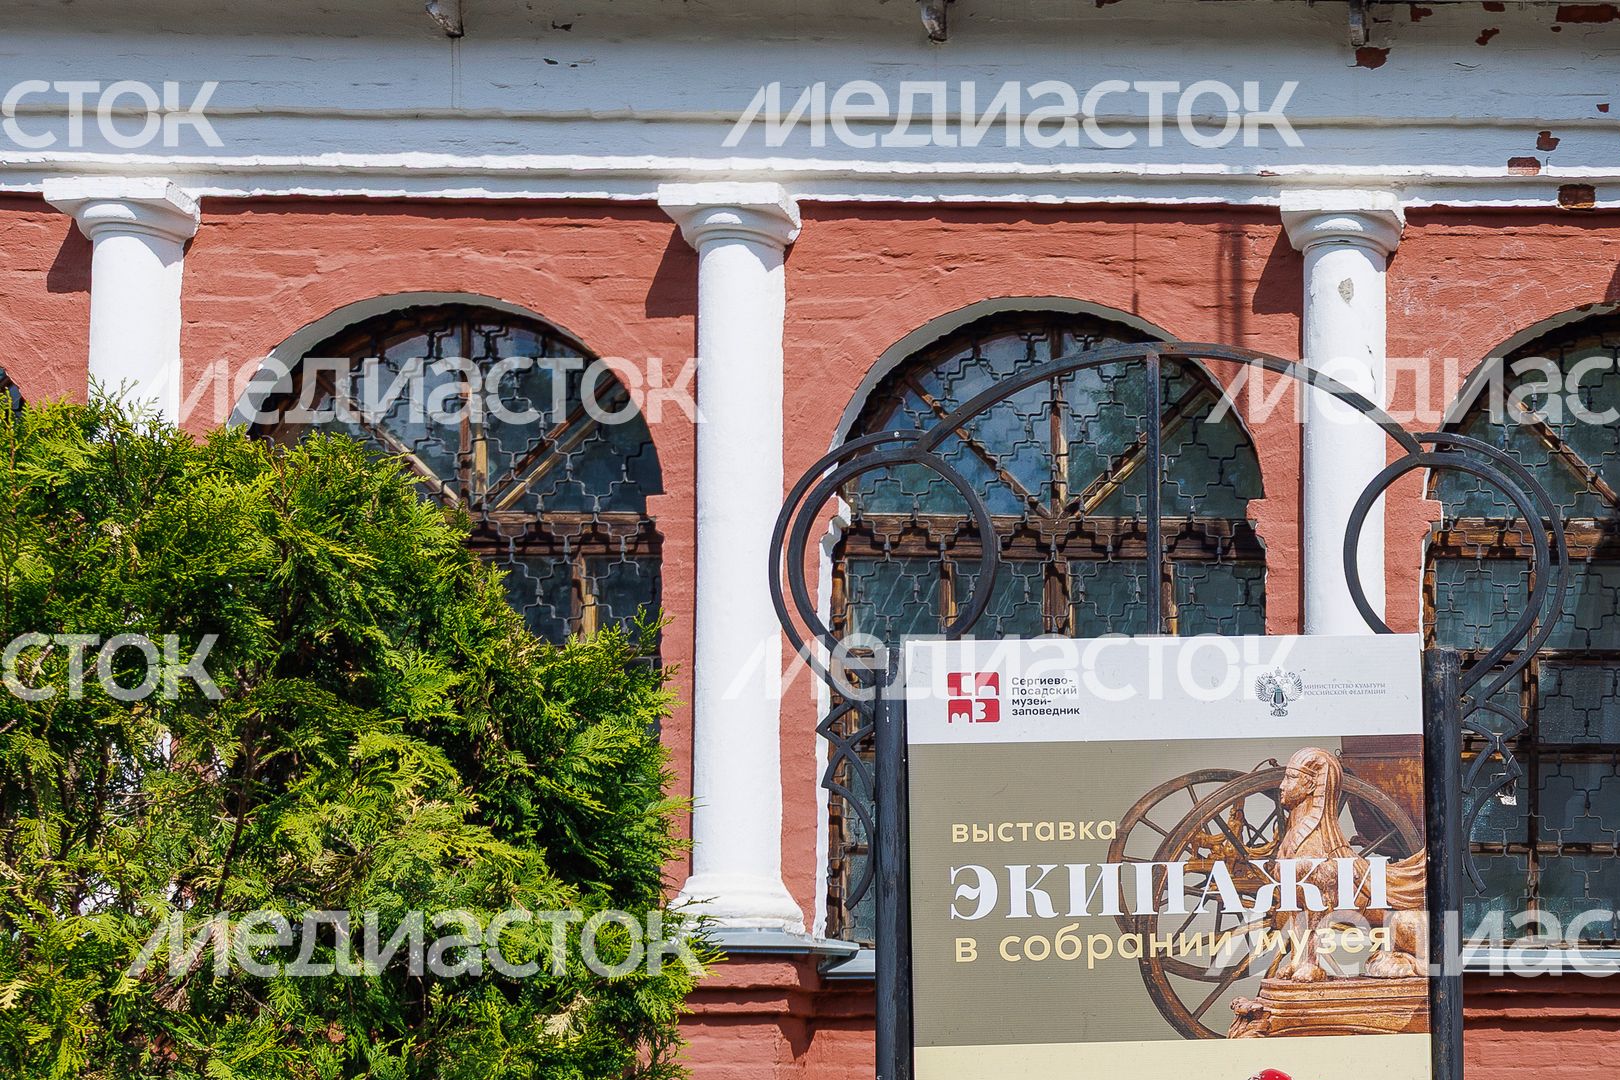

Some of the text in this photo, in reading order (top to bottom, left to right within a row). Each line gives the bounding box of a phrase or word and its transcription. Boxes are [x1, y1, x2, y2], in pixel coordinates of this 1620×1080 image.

[1011, 677, 1073, 688] Сергиево-
[1011, 686, 1077, 697] Посадский
[1011, 696, 1052, 706] музей-
[1011, 707, 1080, 717] заповедник
[951, 818, 1118, 843] выставка
[949, 856, 1392, 922] ЭКИПАЖИ
[955, 922, 1391, 969] в собрании музея
